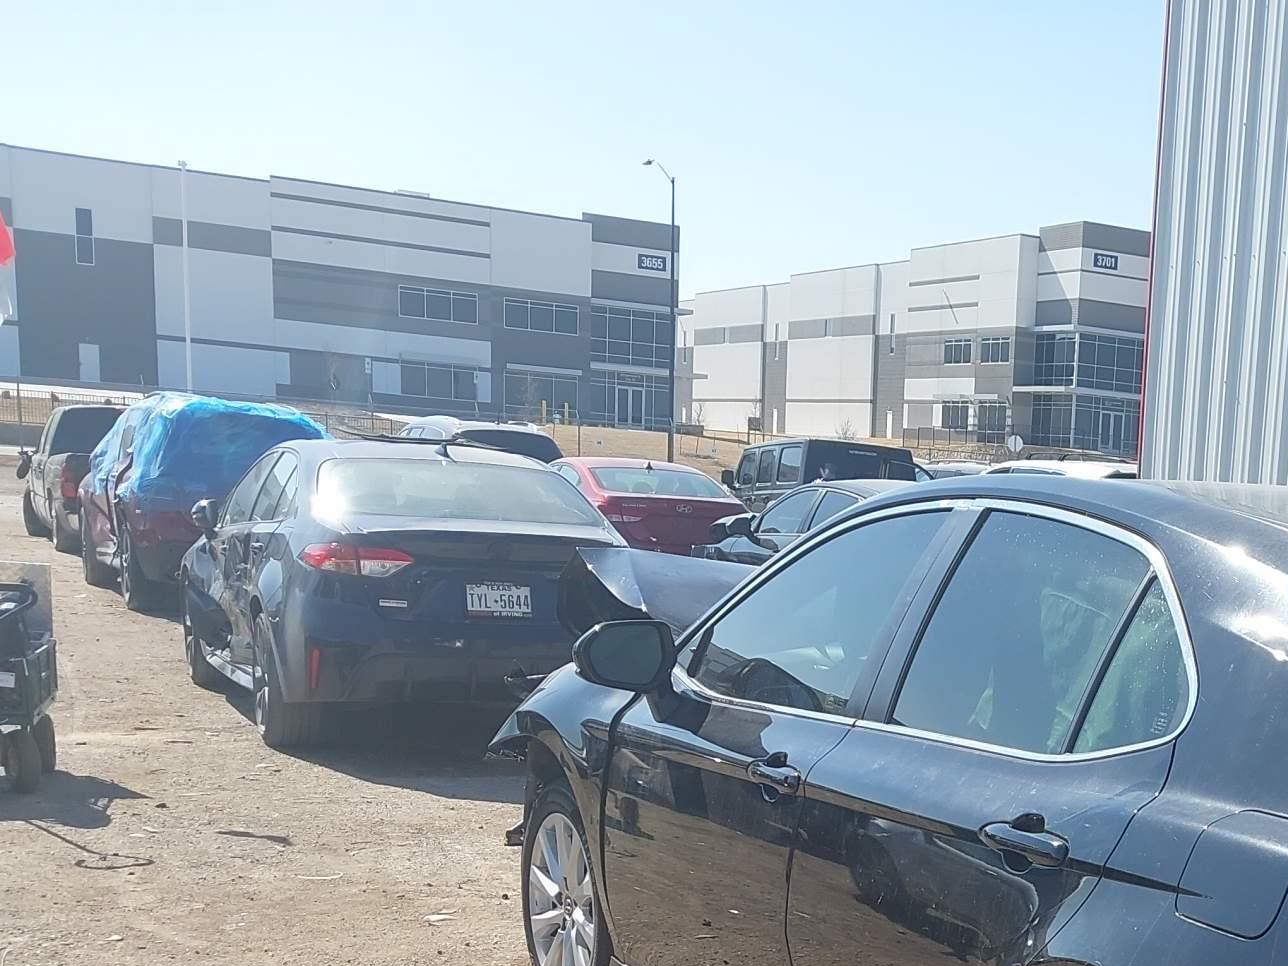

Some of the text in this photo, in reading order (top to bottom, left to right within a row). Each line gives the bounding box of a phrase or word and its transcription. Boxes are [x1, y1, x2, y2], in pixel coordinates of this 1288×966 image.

[641, 256, 664, 269] 3655
[1096, 255, 1116, 268] 3701
[486, 584, 513, 592] TEXAS
